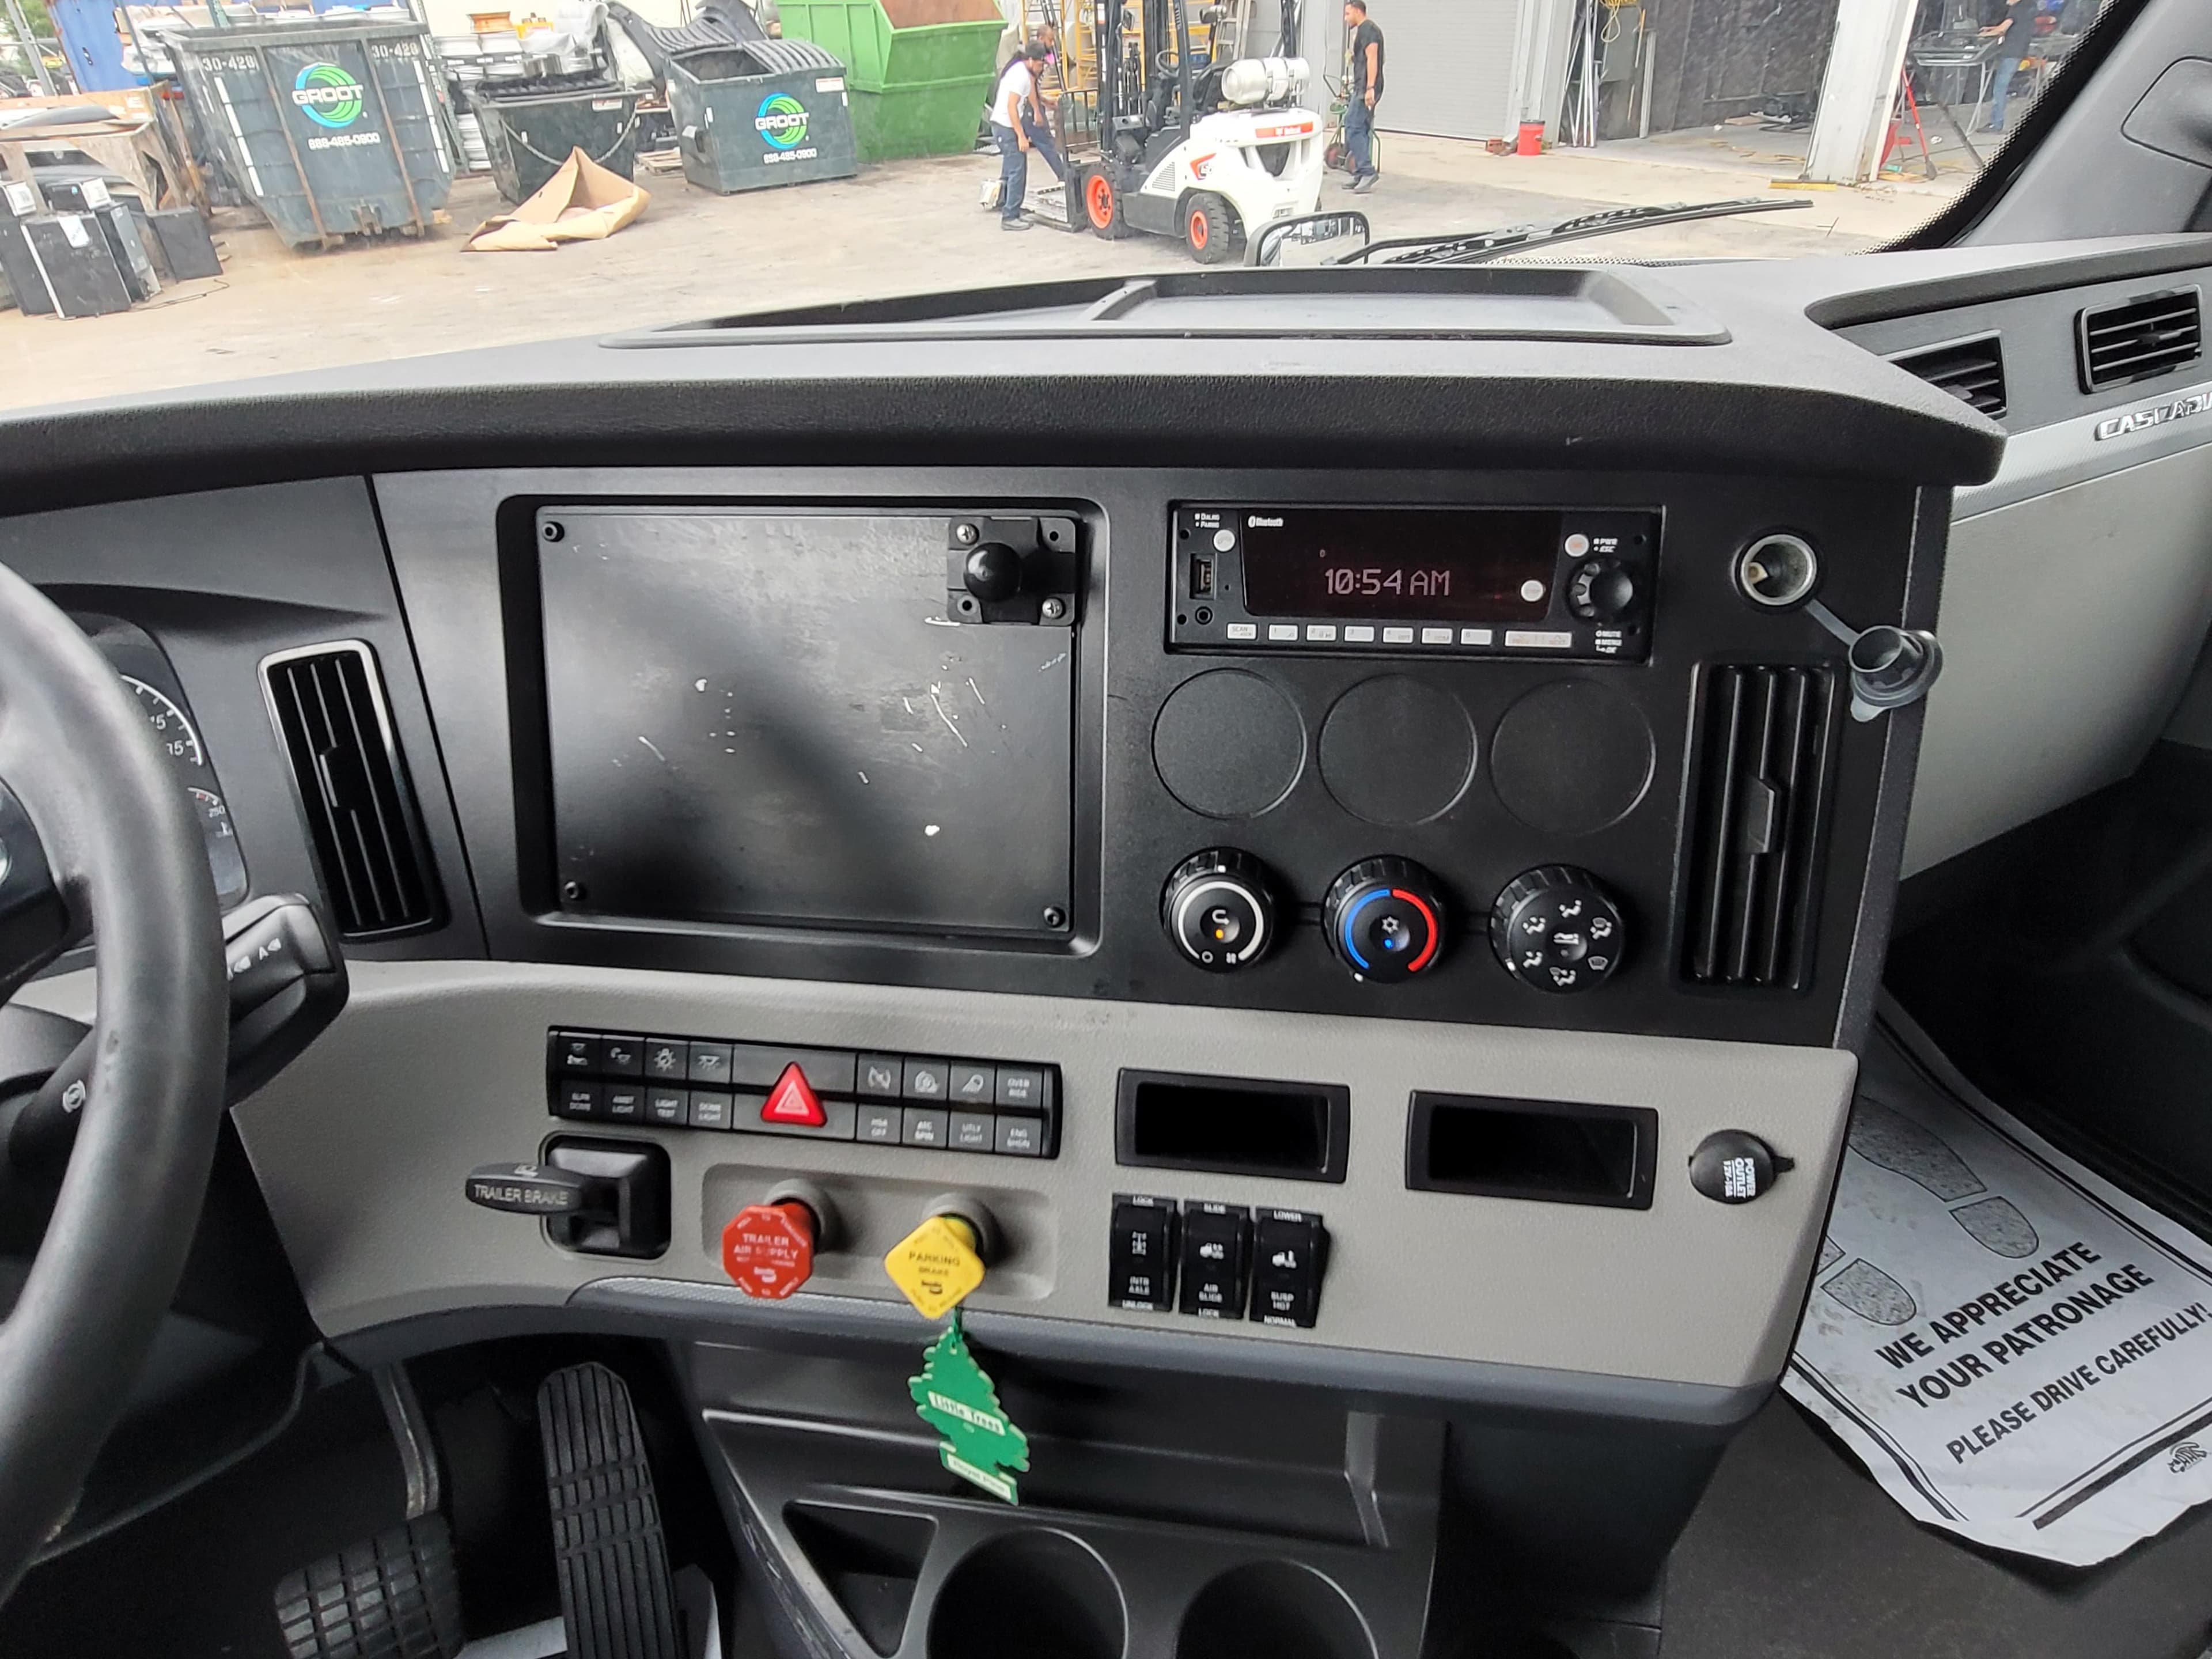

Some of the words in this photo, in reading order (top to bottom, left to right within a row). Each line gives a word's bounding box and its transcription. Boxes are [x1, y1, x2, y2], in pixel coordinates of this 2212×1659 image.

[292, 84, 363, 106] GROOT
[755, 113, 810, 130] GROOT
[1325, 569, 1402, 595] 10:54
[1410, 569, 1450, 597] AM
[1735, 1157, 1746, 1198] OUTLET
[1744, 1157, 1756, 1197] POWER
[474, 1184, 521, 1203] TRAILER
[524, 1188, 569, 1206] BRAKE
[1132, 1195, 1154, 1207] LOCK
[1273, 1210, 1302, 1222] LOWER
[742, 1233, 789, 1247] TRAILER
[733, 1245, 751, 1254] AIR
[756, 1247, 798, 1260] SPPLY
[908, 1251, 961, 1267] PARKING
[1204, 1283, 1219, 1293] AIR
[1198, 1308, 1219, 1319] LOCK
[1874, 1331, 1935, 1370] WE
[1929, 1241, 2102, 1344] APPRECIATE
[1895, 1353, 1994, 1409] YOUR
[1982, 1263, 2155, 1365] PATRONAGE
[1945, 1400, 2036, 1464] PLEASE
[2030, 1364, 2101, 1412] DRIVE
[2094, 1301, 2212, 1376] CAREFULLY!
[934, 1394, 964, 1417] Little
[971, 1410, 1000, 1432] Trees
